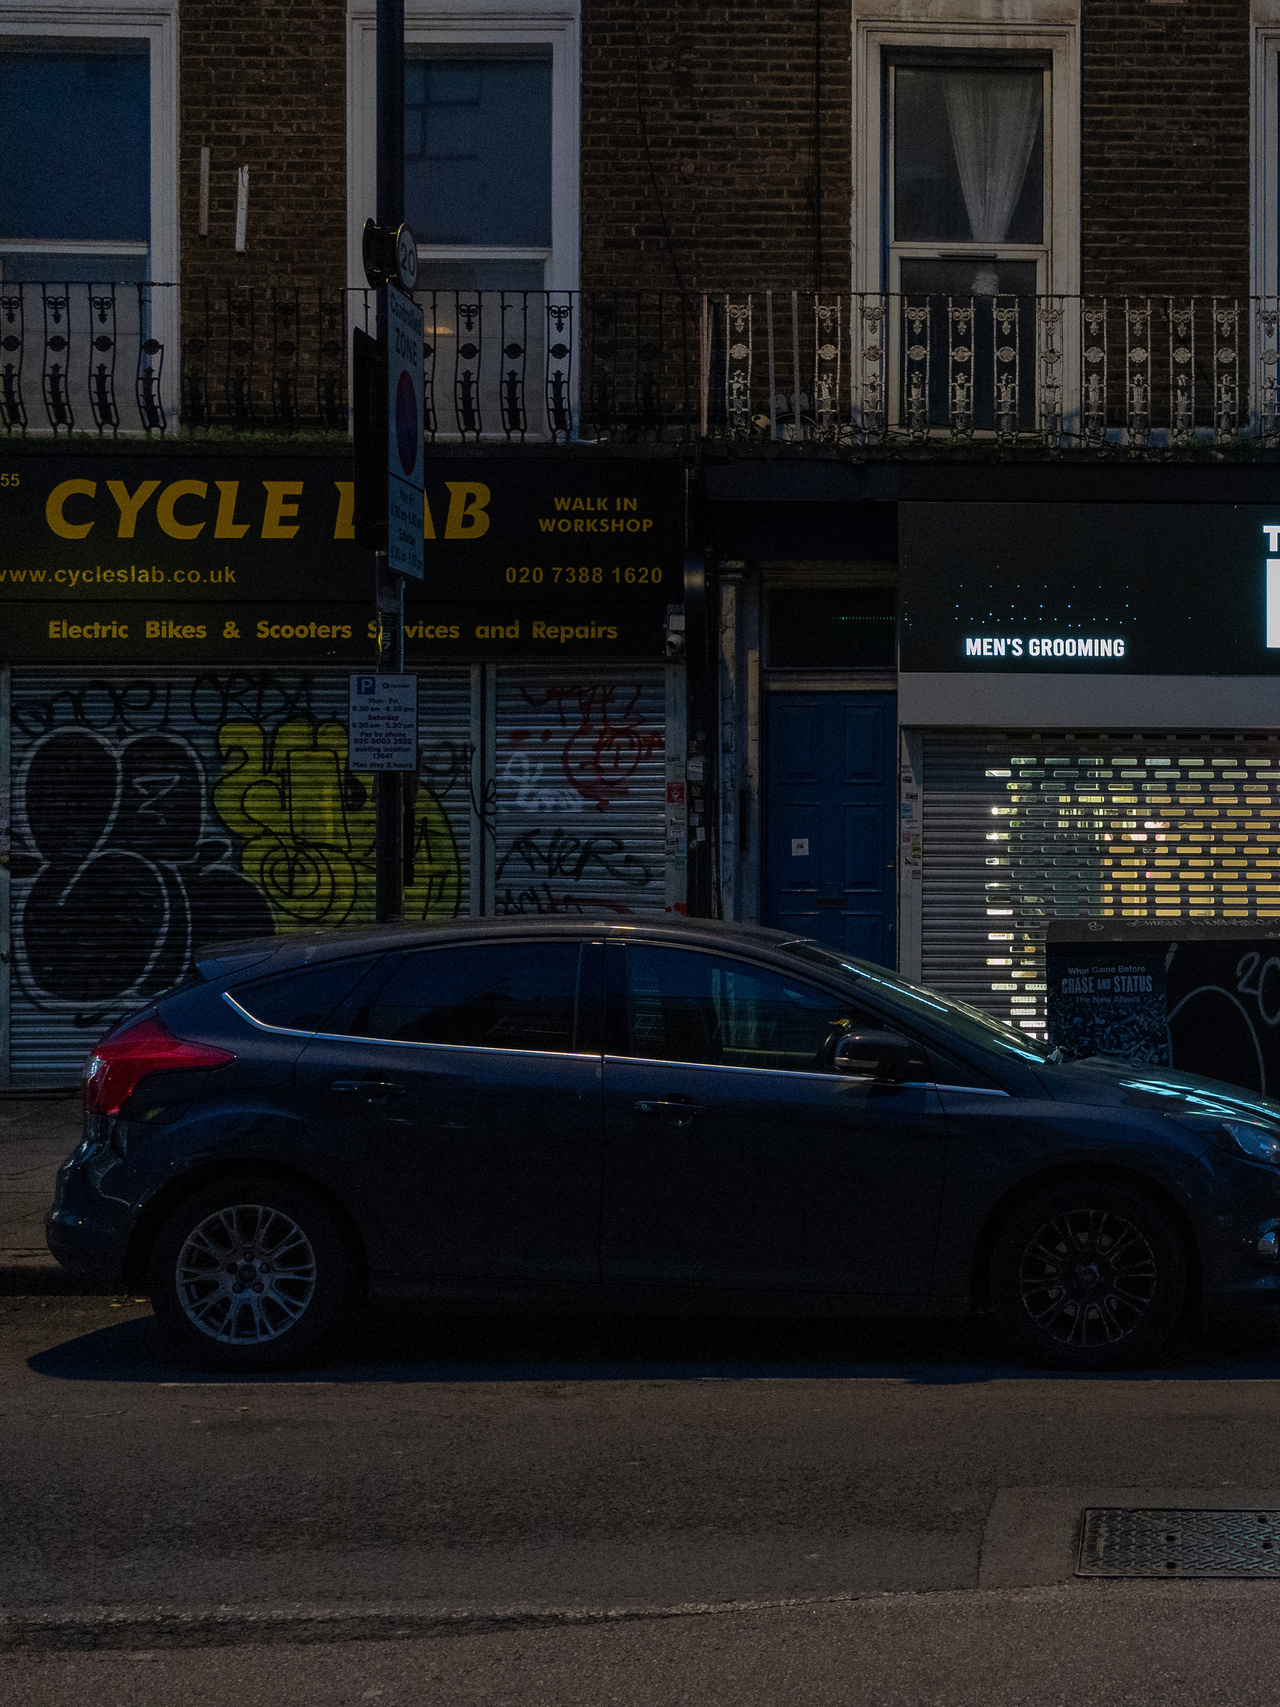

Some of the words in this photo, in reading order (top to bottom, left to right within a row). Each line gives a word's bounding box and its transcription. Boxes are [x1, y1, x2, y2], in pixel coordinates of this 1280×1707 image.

[400, 242, 416, 277] 20
[395, 326, 418, 368] ZONE
[45, 478, 304, 540] CYCLE
[333, 481, 492, 540] LB
[553, 497, 609, 511] WALK
[616, 497, 638, 511] IN
[538, 518, 654, 533] WORKSHOP
[505, 566, 544, 584] 020
[552, 566, 604, 584] 7388
[611, 566, 663, 584] 1620
[48, 620, 129, 639] Electric
[145, 620, 207, 639] Bikes
[222, 620, 241, 639] &
[256, 620, 353, 639] Scooters
[367, 620, 460, 639] Svices
[475, 620, 520, 639] and
[532, 620, 619, 644] Repairs
[965, 637, 1023, 656] MEN'S
[1028, 638, 1125, 657] GROOMING
[1068, 967, 1090, 975] What
[1091, 966, 1116, 974] Came
[1117, 964, 1146, 973] Before
[1061, 976, 1095, 994] CHASE
[1097, 978, 1112, 990] AND
[1113, 975, 1153, 993] STATUS
[1076, 995, 1092, 1004] The
[1093, 995, 1112, 1004] New
[1114, 995, 1141, 1004] Album
